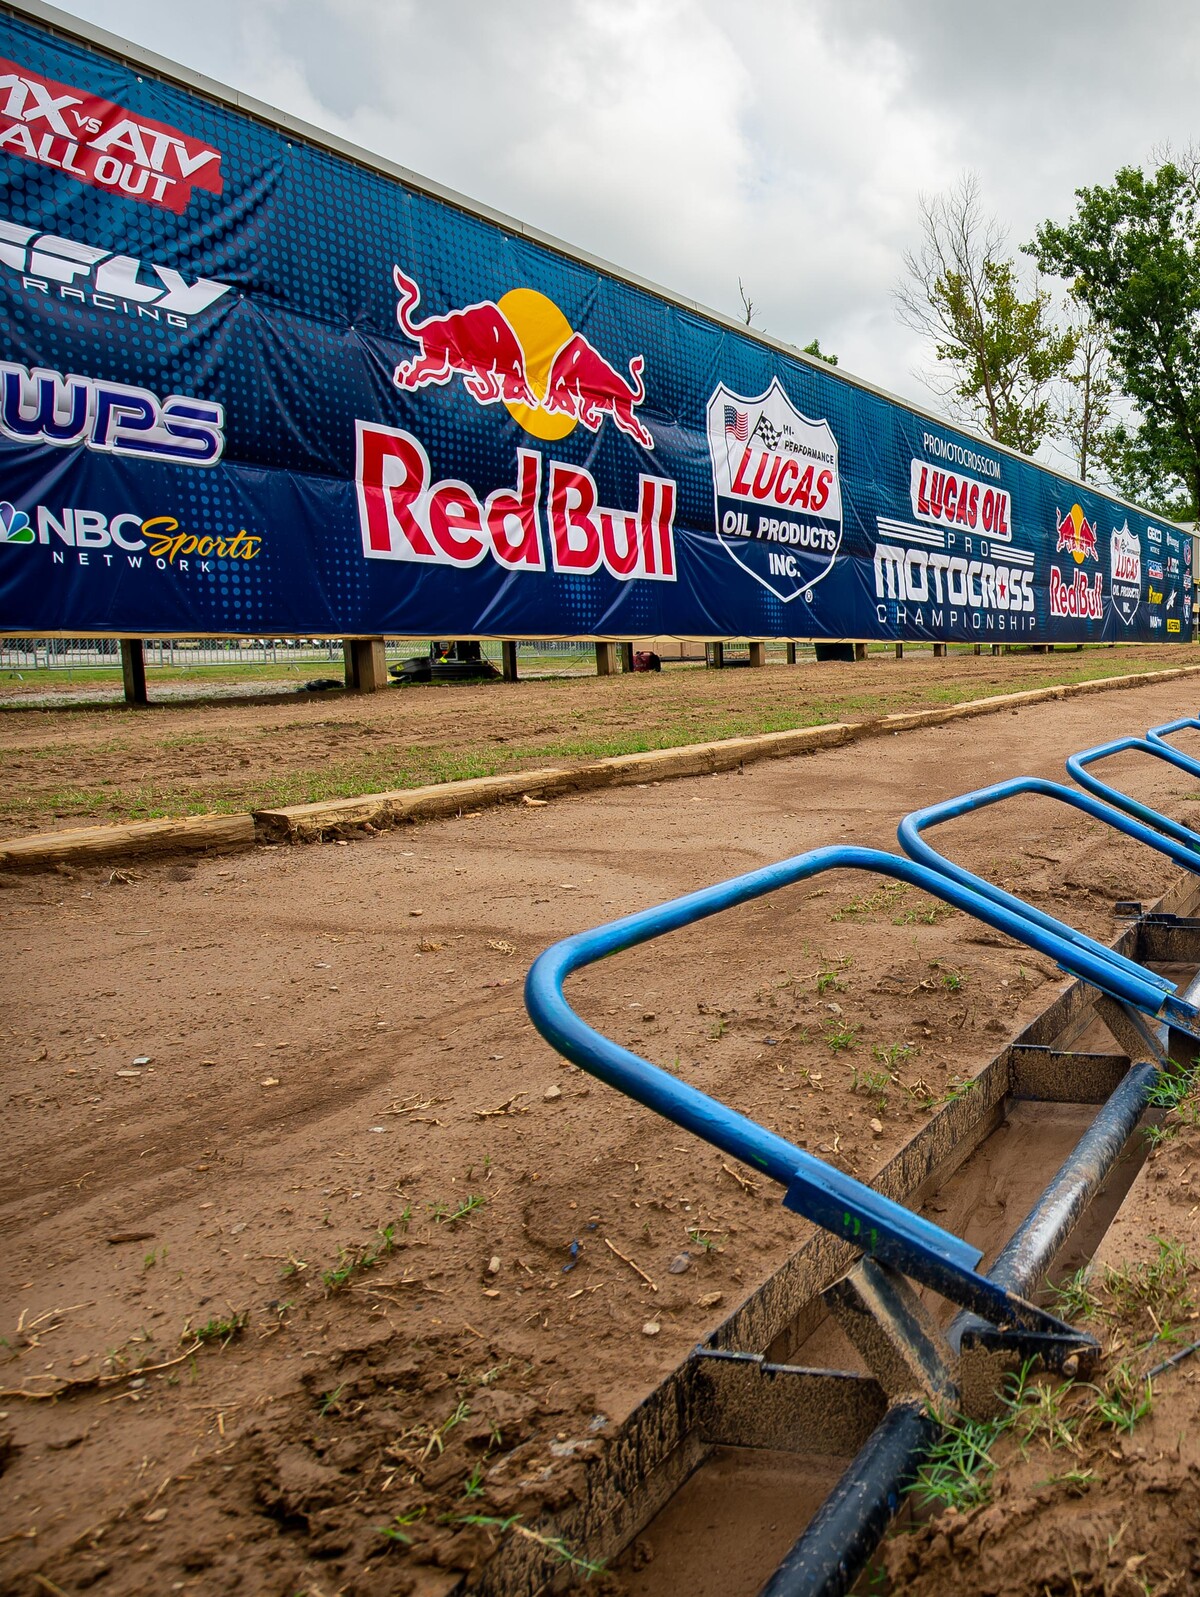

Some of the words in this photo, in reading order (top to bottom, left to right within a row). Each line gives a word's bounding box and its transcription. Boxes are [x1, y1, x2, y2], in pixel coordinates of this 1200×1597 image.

[0, 123, 86, 176] ALL
[93, 159, 176, 202] OUT
[86, 118, 221, 178] ATV
[23, 276, 188, 328] RACING
[0, 366, 224, 464] WPS
[731, 447, 833, 512] LUCAS
[784, 440, 834, 465] PERFORMANCE
[355, 419, 546, 572] Red
[548, 460, 677, 582] Bull
[917, 467, 979, 529] LUCAS
[981, 489, 1008, 536] OIL
[37, 505, 147, 551] NBC
[141, 516, 262, 564] Sports
[722, 510, 752, 536] OIL
[757, 517, 836, 551] PRODUCTS
[947, 532, 989, 557] PRO
[53, 551, 211, 573] NETWORK
[769, 552, 801, 577] INC.
[874, 543, 1035, 612] MOTOCROSS
[1115, 554, 1139, 580] LUCAS
[876, 604, 1036, 631] CHAMPIONSHIP
[1050, 565, 1079, 618] Red
[1078, 571, 1103, 619] Bull
